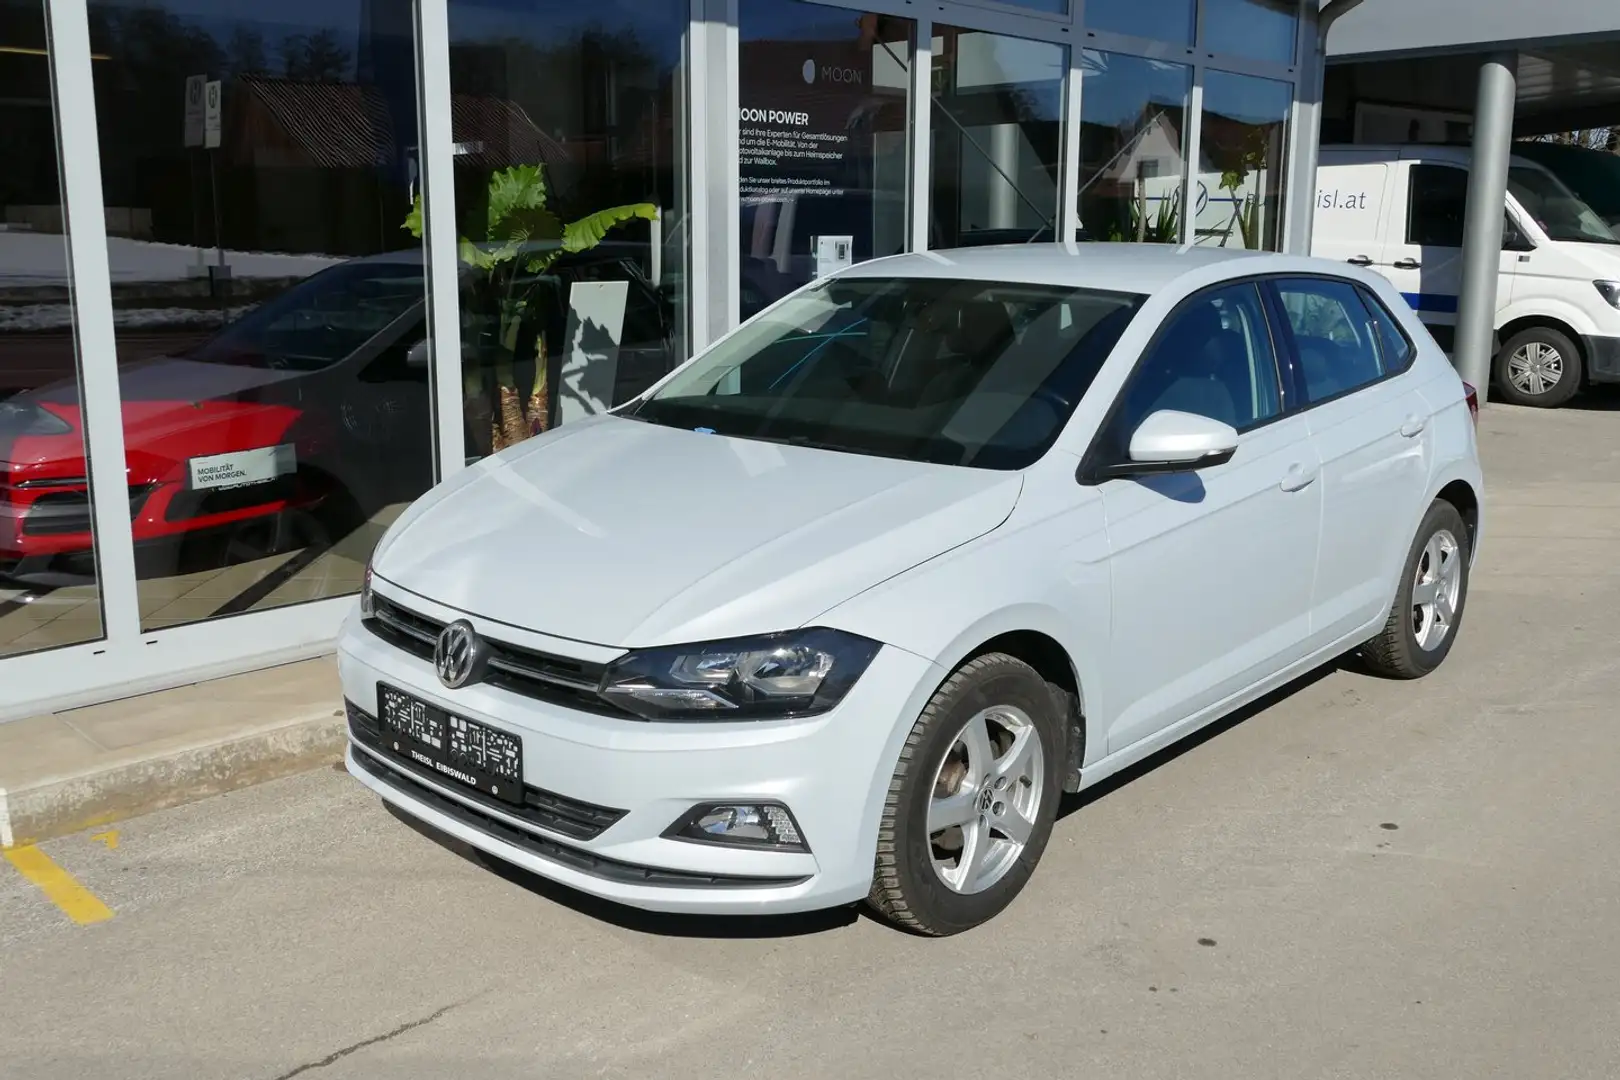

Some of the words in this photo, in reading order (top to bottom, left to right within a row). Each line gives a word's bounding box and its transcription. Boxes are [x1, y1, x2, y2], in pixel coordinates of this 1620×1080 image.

[822, 66, 862, 84] MOON
[739, 107, 767, 123] OON
[768, 109, 809, 126] POWER
[767, 129, 793, 140] Experten
[793, 131, 801, 139] für
[801, 131, 848, 143] Gesamtlösungen
[756, 138, 766, 146] die
[808, 141, 819, 149] der
[784, 149, 793, 157] bis
[793, 150, 806, 158] zum
[806, 150, 843, 160] Heimspeicher
[748, 176, 757, 184] Sie
[805, 188, 832, 196] Homepage
[831, 188, 844, 196] unter
[197, 463, 234, 476] MOBILITÄT
[197, 474, 214, 483] VON
[411, 750, 434, 768] THEISL
[436, 761, 477, 786] EIBISWALD
